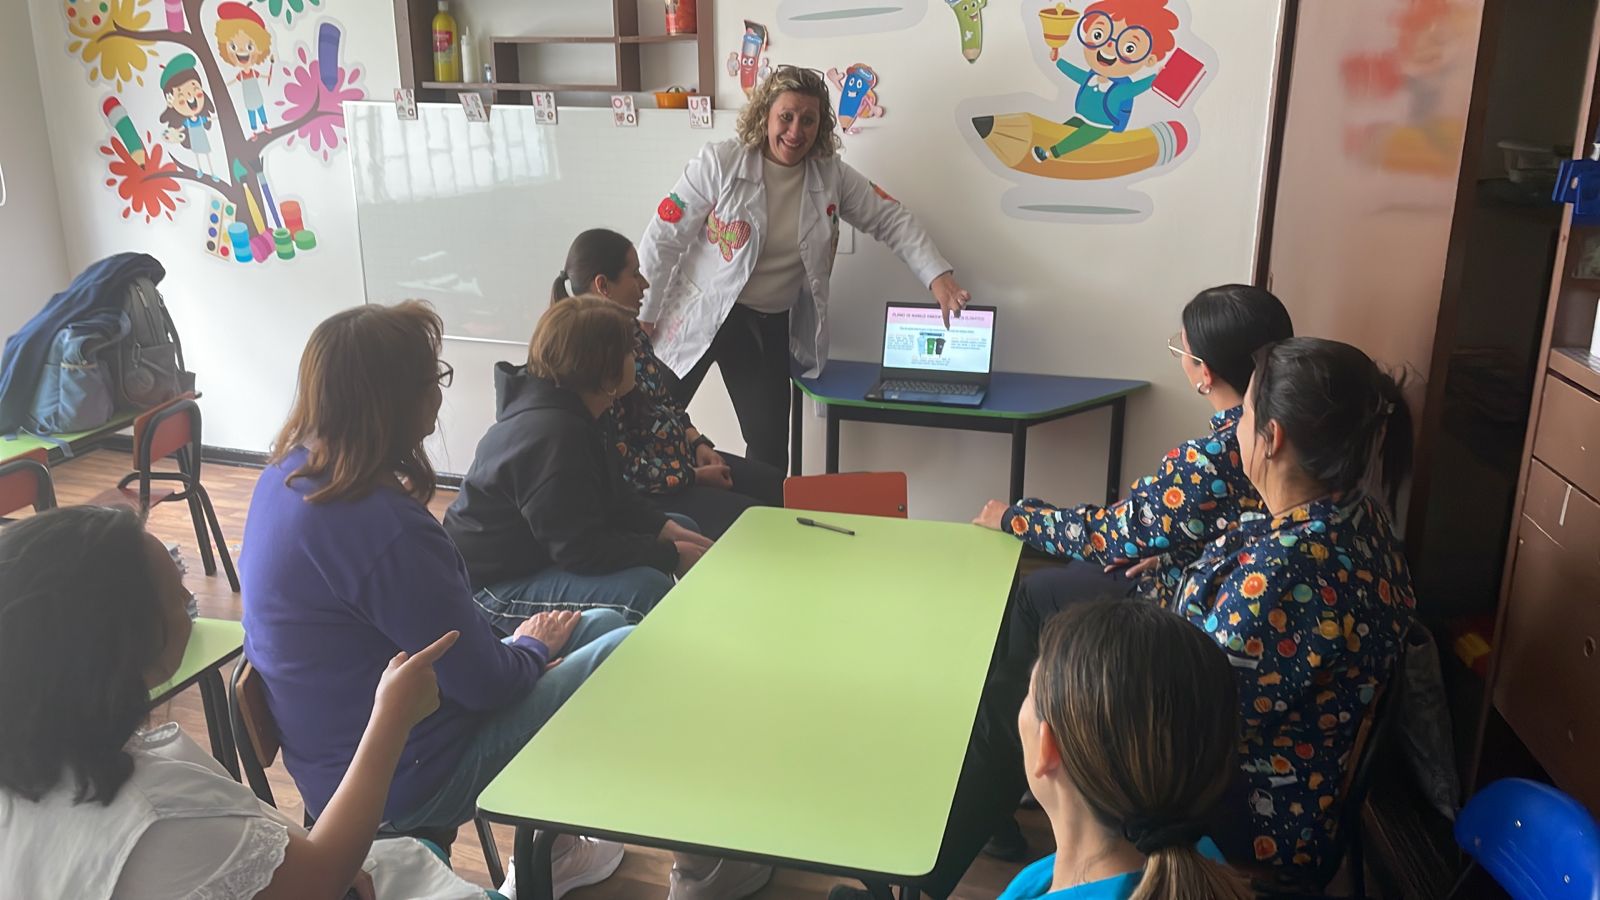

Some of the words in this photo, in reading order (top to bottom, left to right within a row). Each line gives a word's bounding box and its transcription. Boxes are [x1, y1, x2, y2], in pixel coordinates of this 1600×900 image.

[396, 90, 403, 102] A
[536, 94, 543, 106] E
[613, 97, 623, 109] O
[690, 99, 699, 110] U
